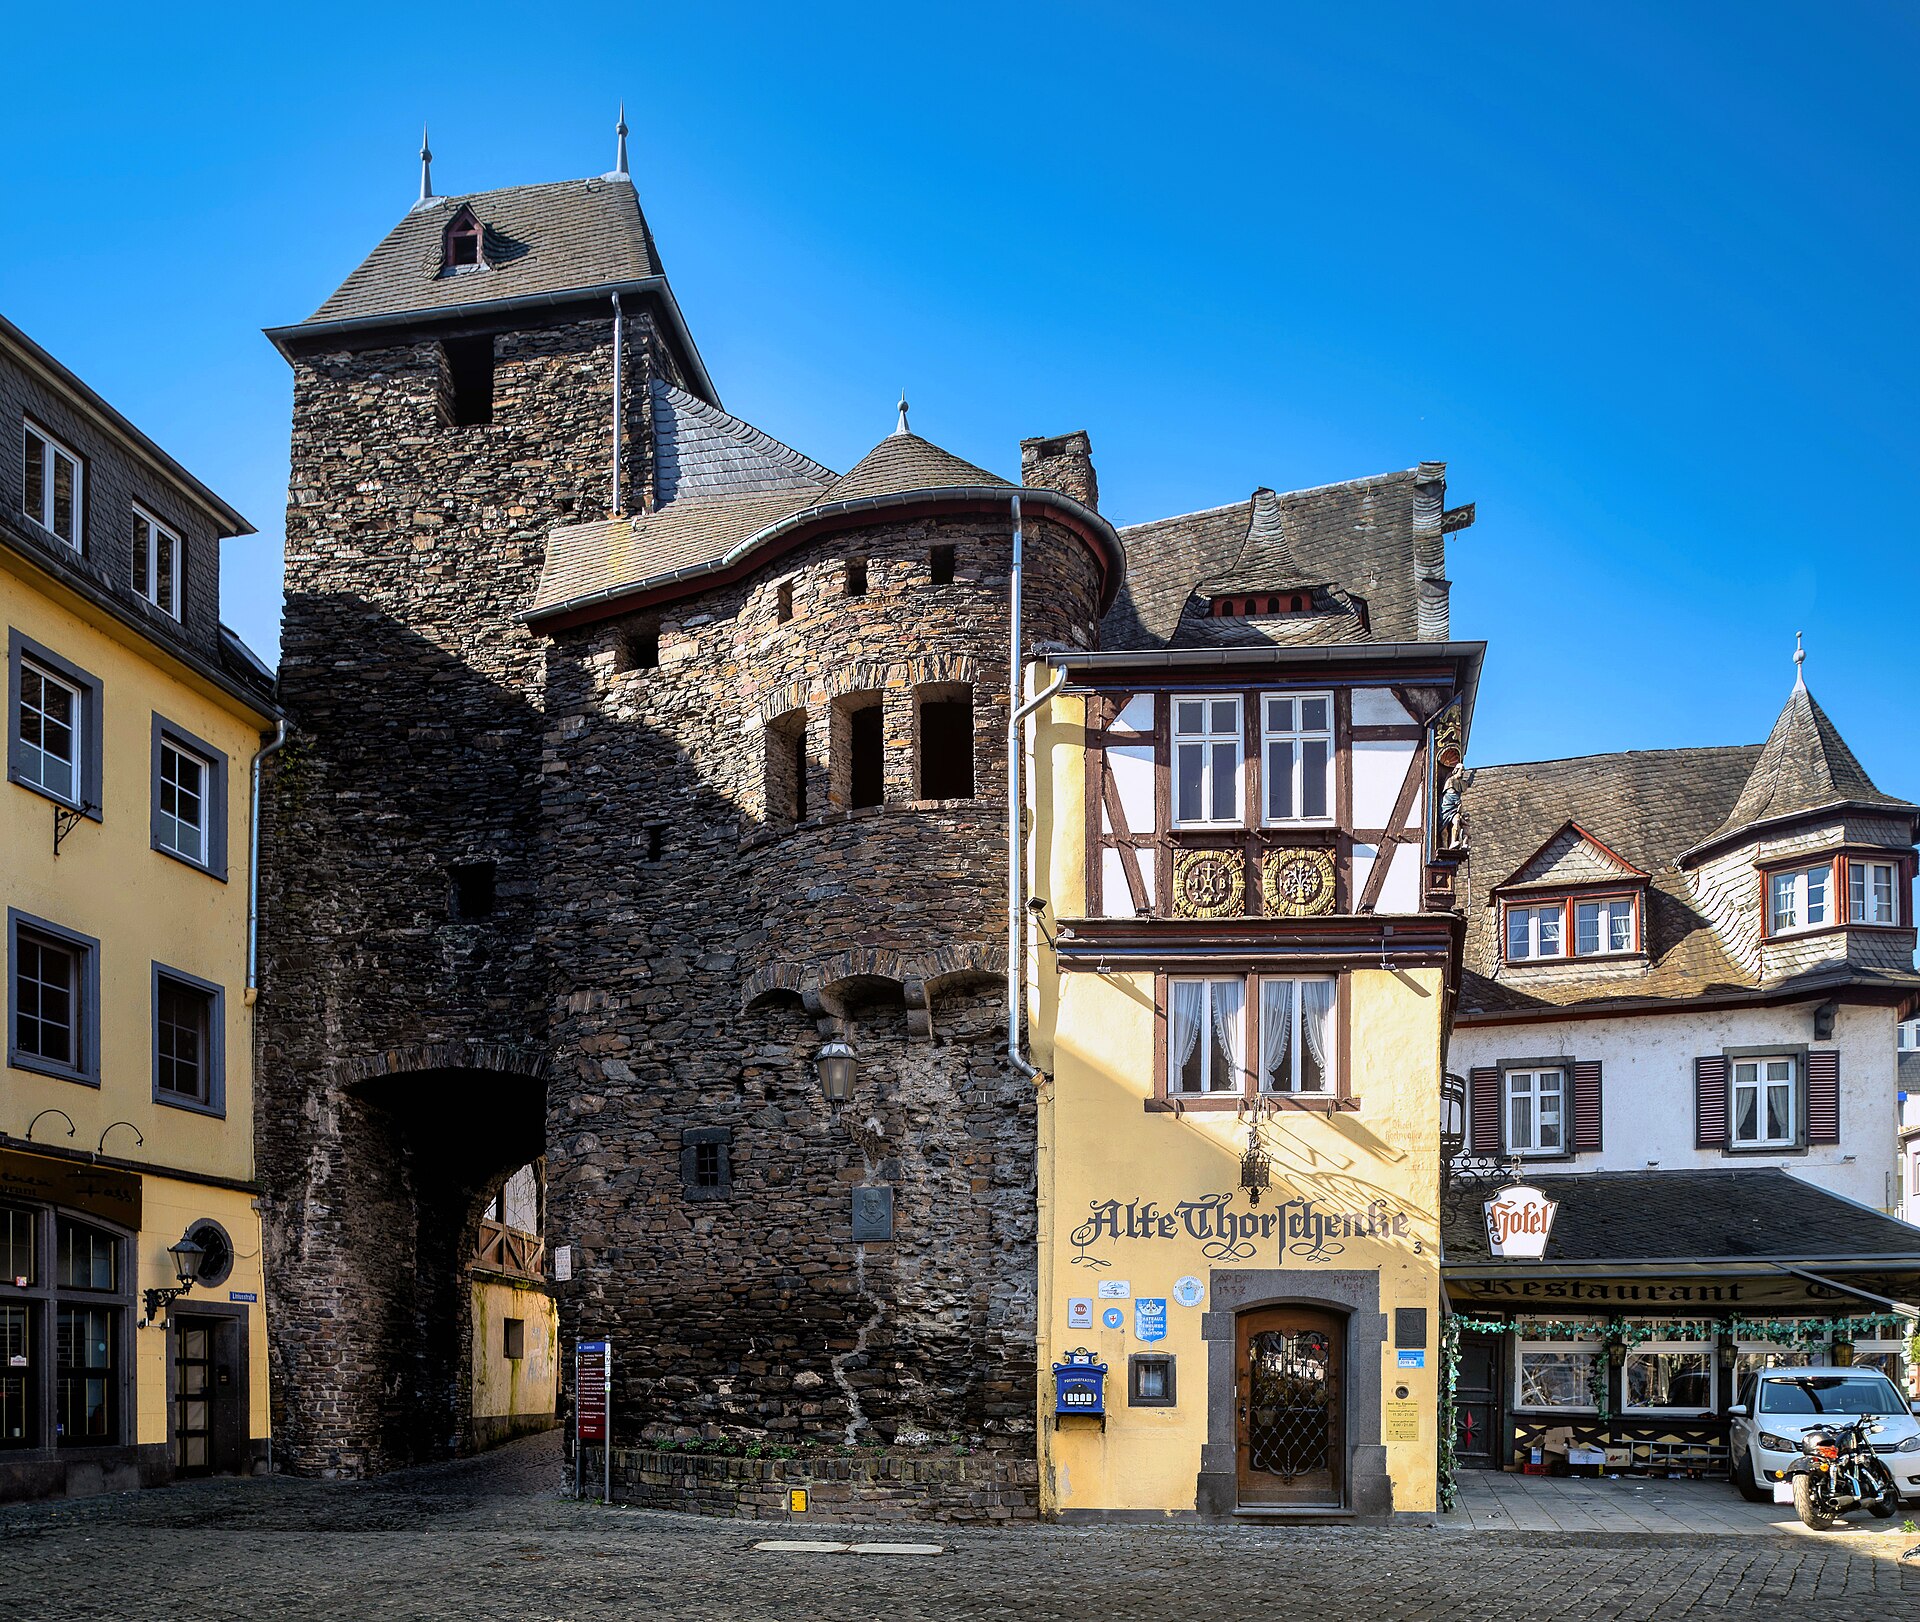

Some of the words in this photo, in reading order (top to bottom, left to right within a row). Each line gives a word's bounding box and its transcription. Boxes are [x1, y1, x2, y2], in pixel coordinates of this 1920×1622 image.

[1070, 1196, 1179, 1262] Alte
[1486, 1200, 1553, 1246] Hotel
[1412, 1240, 1423, 1255] 3
[1472, 1278, 1746, 1301] Restaurant
